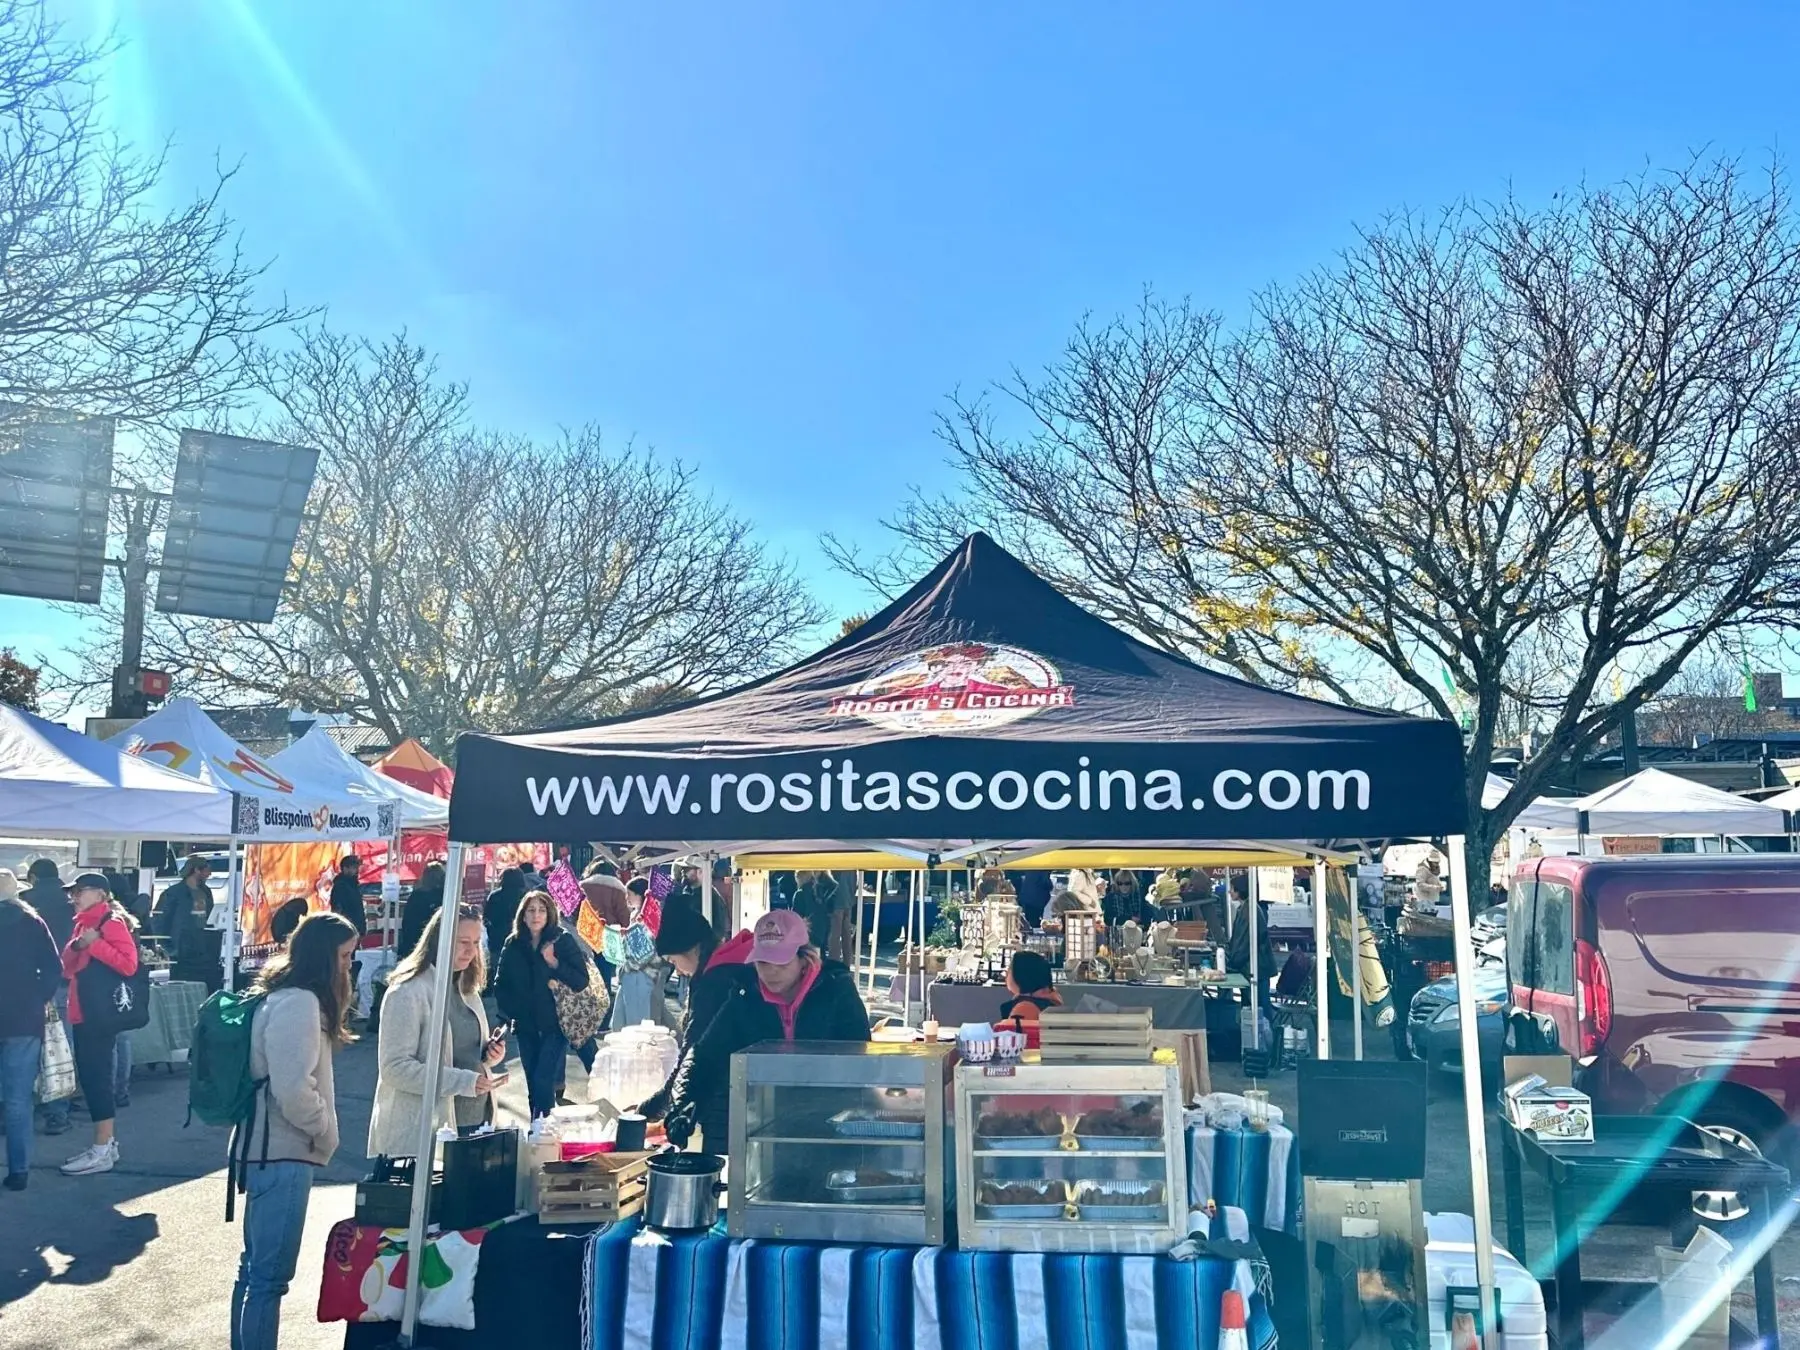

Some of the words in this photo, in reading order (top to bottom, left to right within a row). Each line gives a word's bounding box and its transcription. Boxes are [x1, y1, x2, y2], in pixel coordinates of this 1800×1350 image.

[526, 757, 1371, 816] www.rositascocina.com
[264, 806, 315, 830] Blisspoint
[329, 812, 371, 831] Meadery
[1344, 1200, 1380, 1215] HOT
